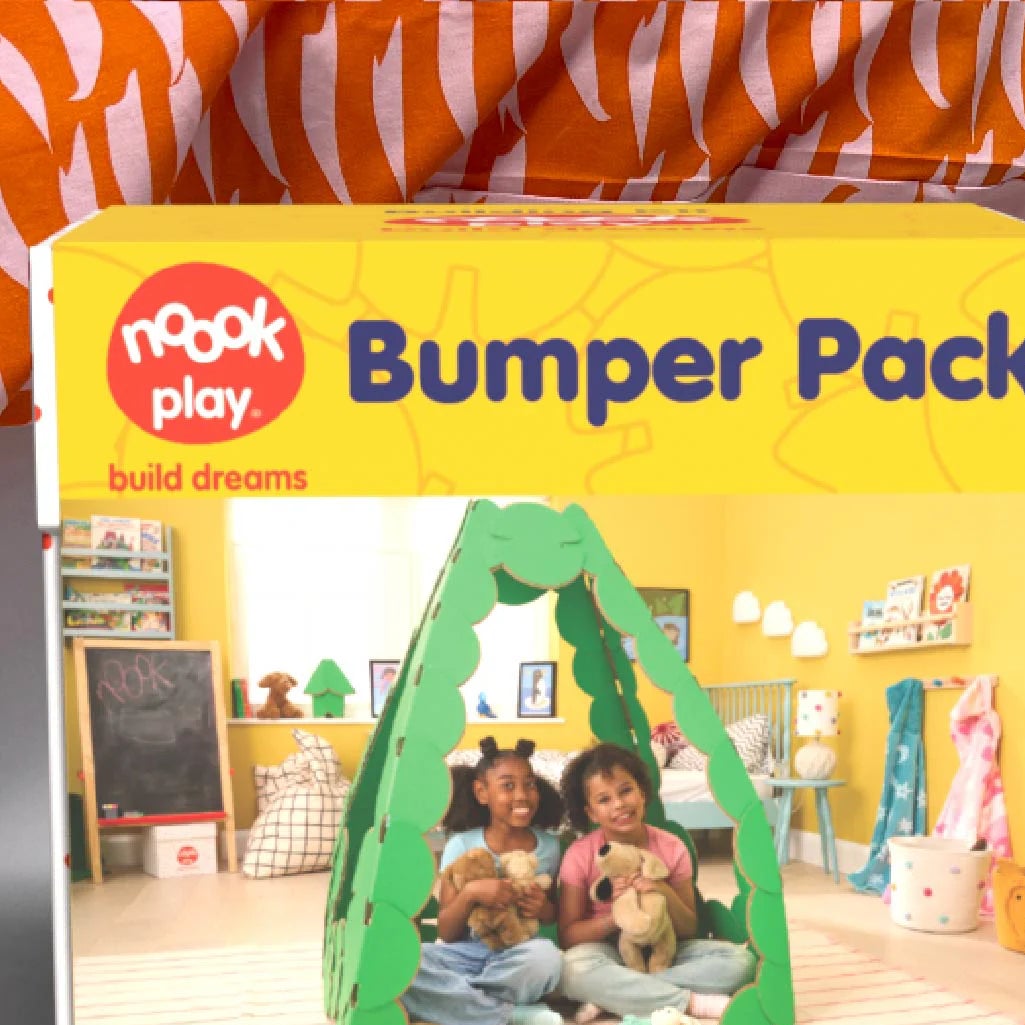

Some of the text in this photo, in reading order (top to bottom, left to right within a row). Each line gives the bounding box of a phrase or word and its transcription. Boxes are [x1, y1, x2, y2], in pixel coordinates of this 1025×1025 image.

[348, 319, 763, 427] Bumper
[152, 374, 252, 431] play
[109, 463, 307, 491] build dreams
